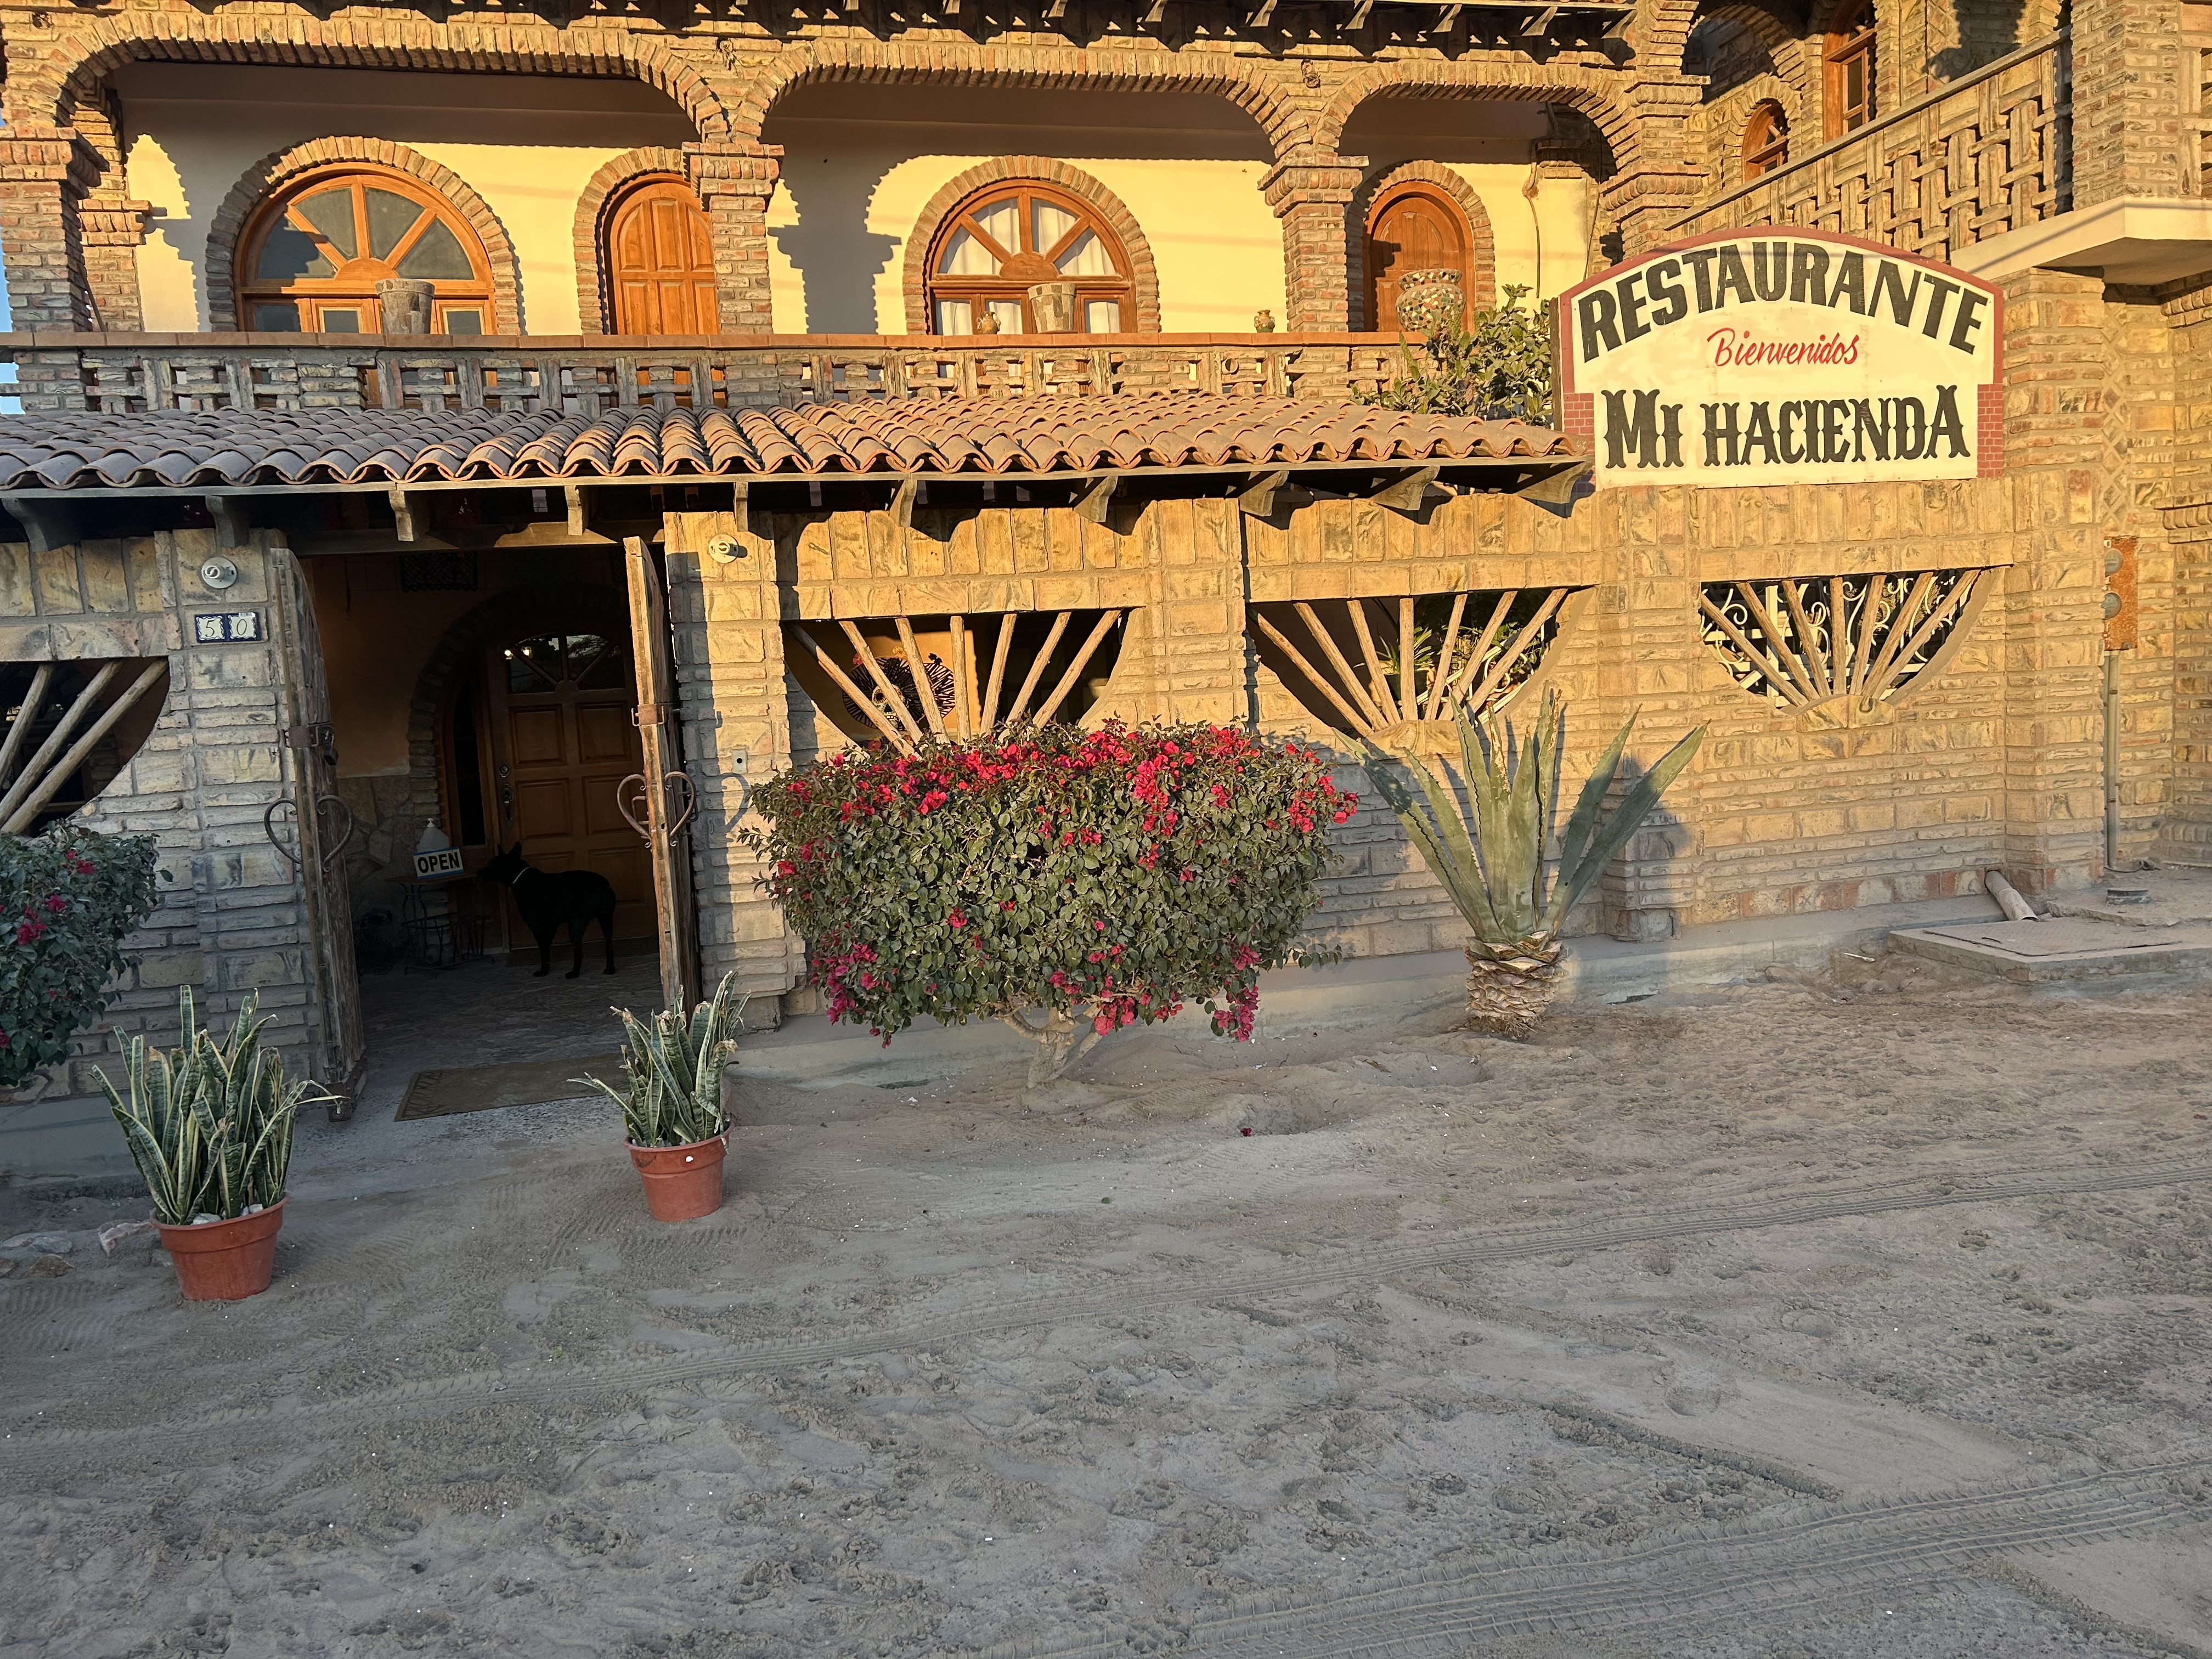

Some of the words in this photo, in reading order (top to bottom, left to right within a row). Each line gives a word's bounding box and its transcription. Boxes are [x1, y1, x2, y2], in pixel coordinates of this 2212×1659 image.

[1578, 241, 1990, 363] RESTAURANTE
[1707, 328, 1859, 366] Bienvenidos
[1601, 389, 1684, 469] MI
[1700, 385, 1971, 466] HACIENDA
[417, 851, 460, 873] OPEN
